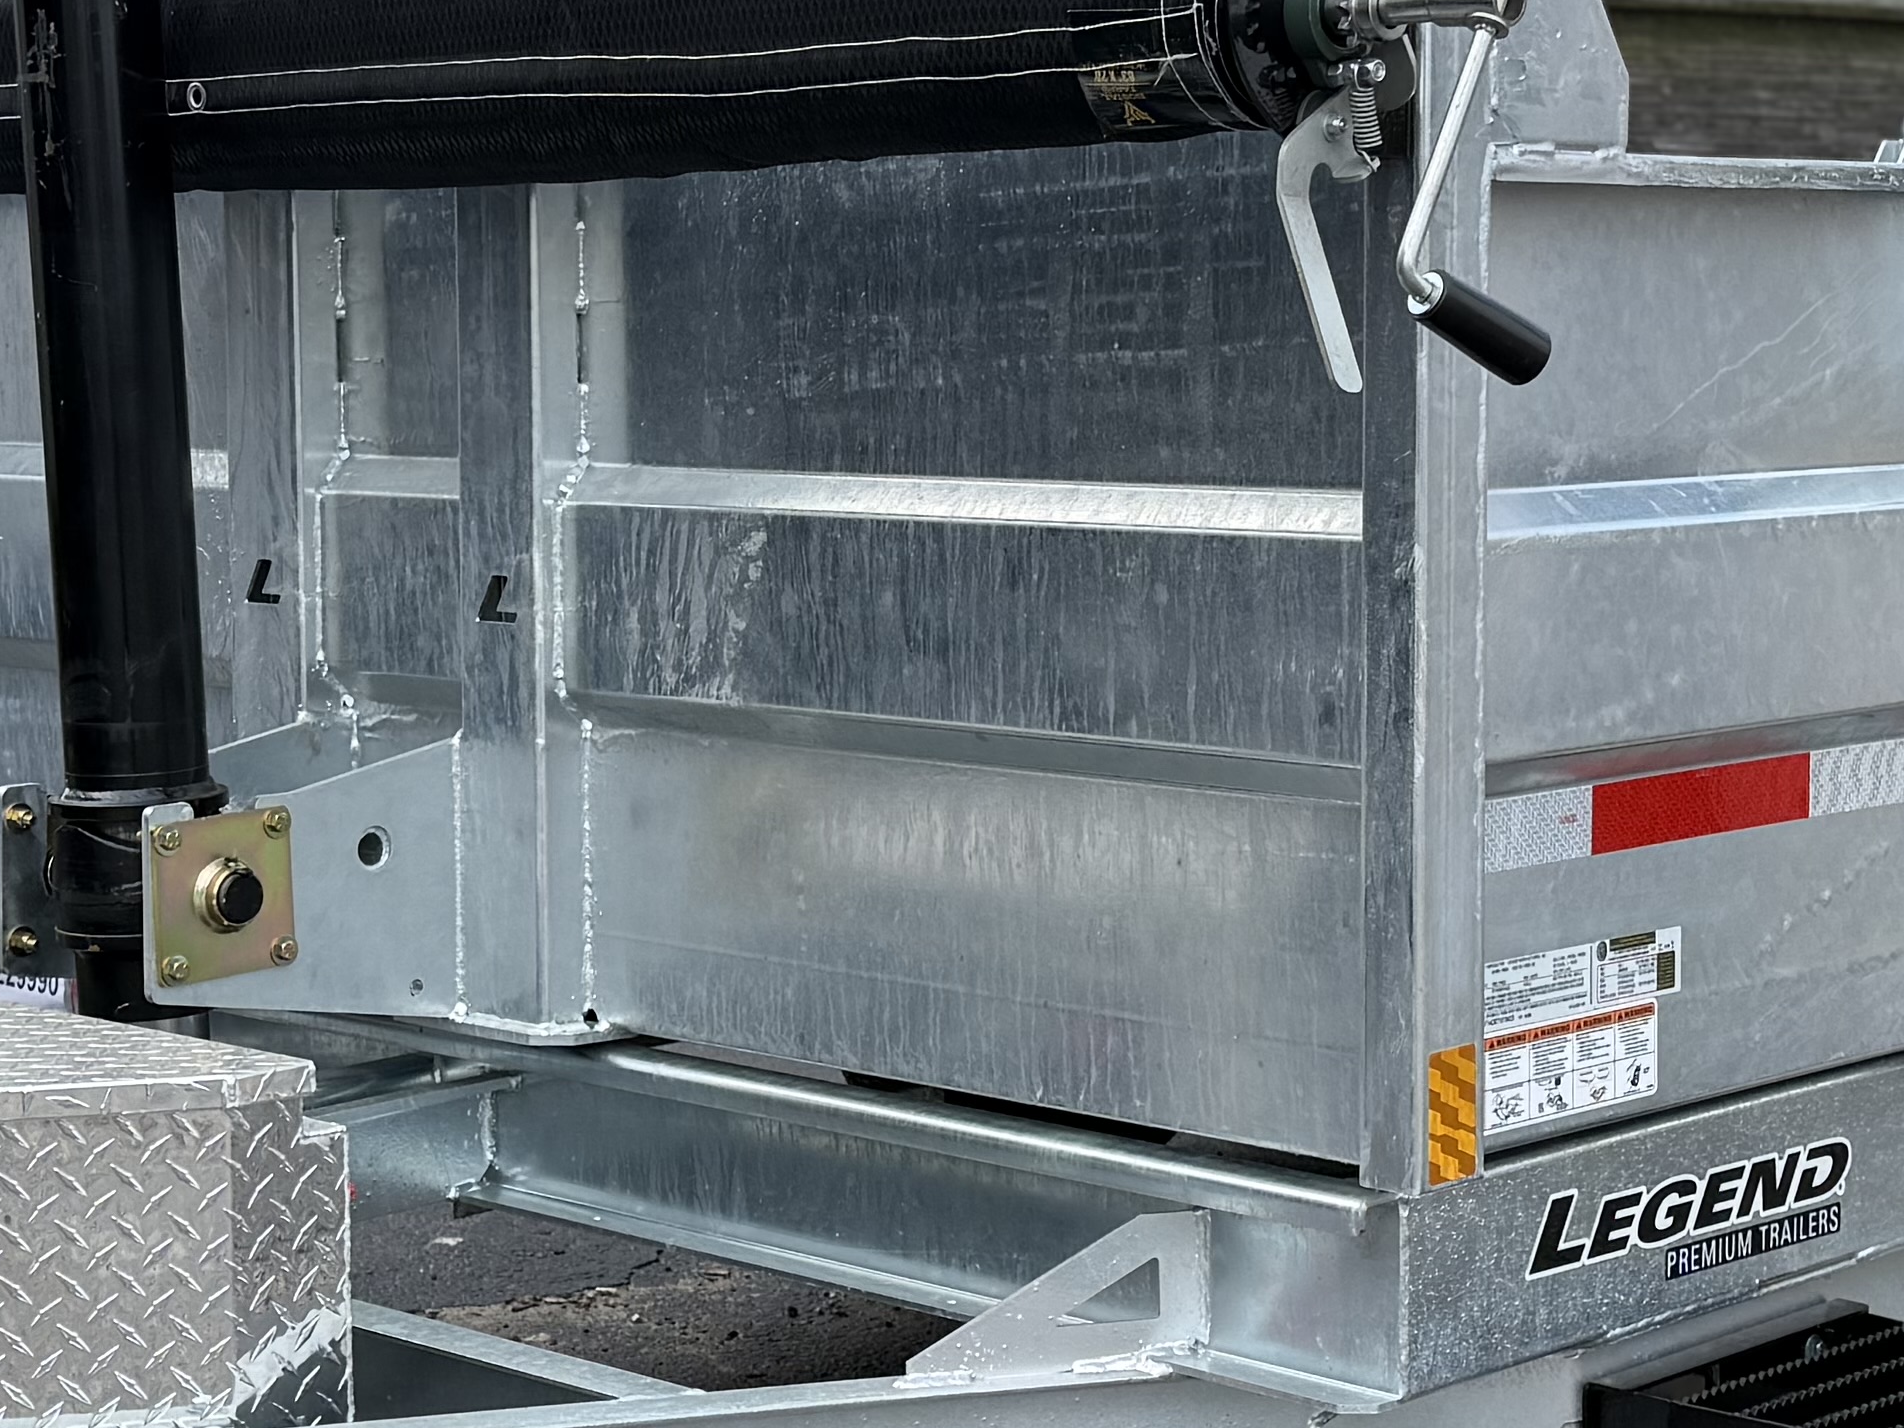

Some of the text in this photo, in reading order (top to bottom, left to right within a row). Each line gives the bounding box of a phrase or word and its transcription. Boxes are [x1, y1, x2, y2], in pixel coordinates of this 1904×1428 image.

[1529, 1140, 1850, 1276] LEGEND
[1666, 1205, 1840, 1278] PREMIUM TRAILERS
